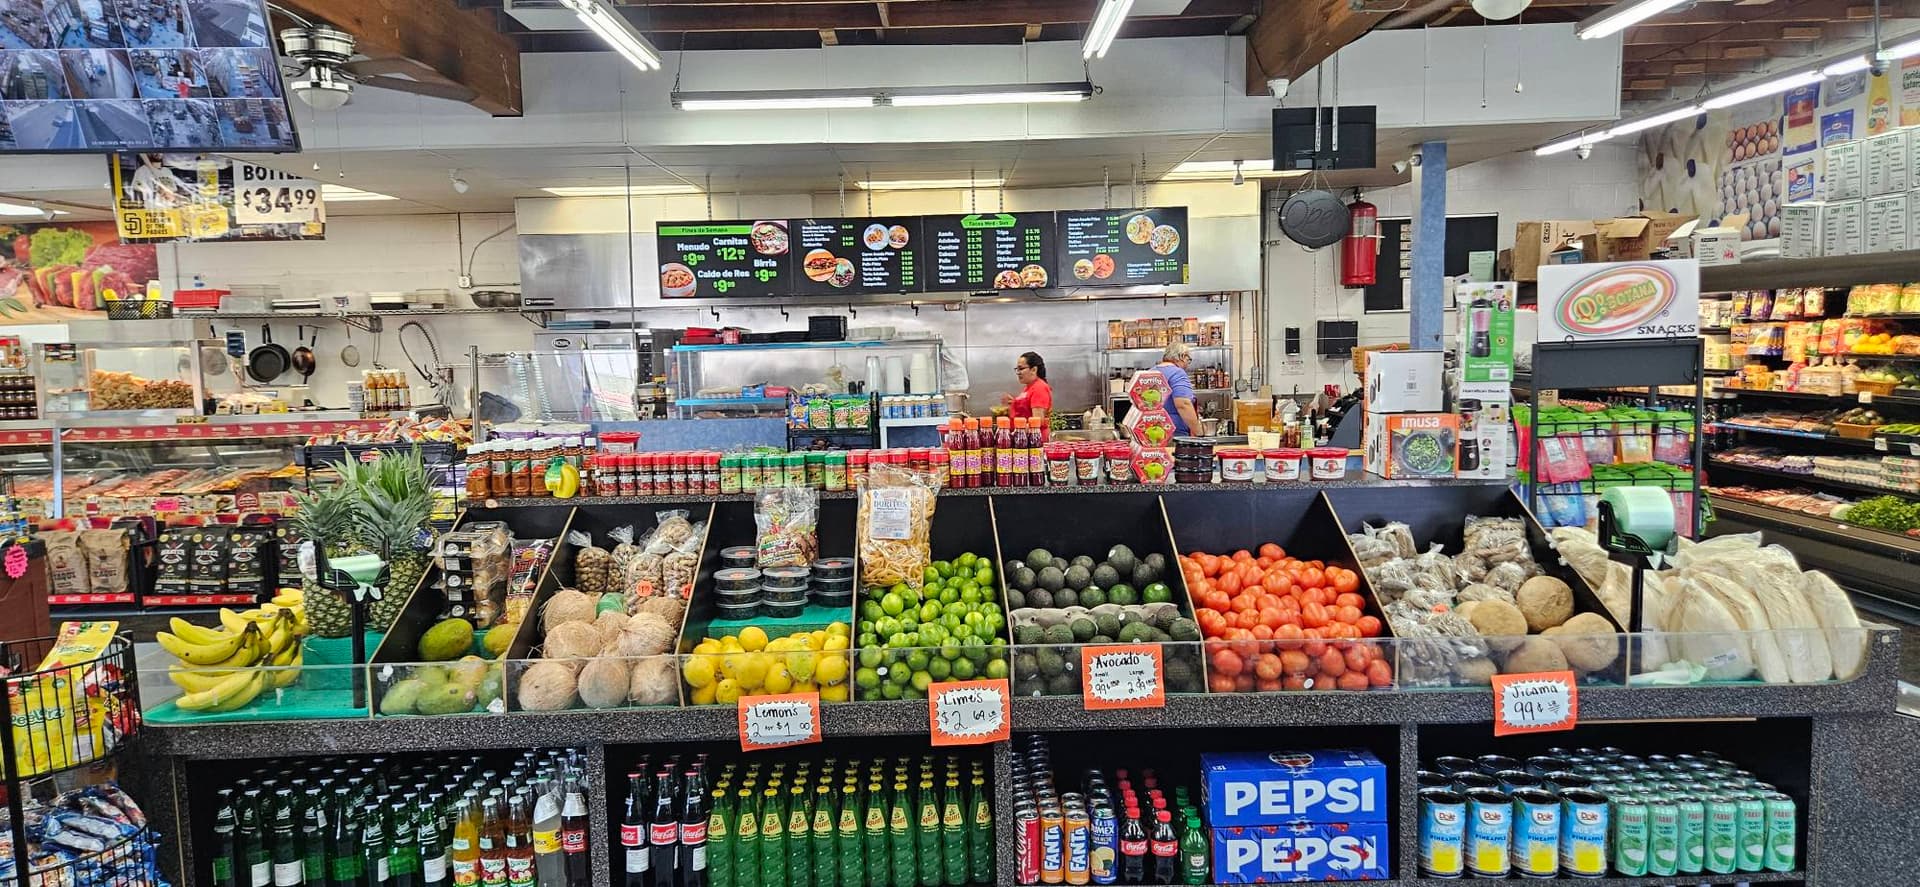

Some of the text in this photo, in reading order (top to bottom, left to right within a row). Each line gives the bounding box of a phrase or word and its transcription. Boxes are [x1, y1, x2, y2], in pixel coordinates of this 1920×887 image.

[713, 237, 748, 245] Carnitas
[677, 243, 710, 252] Menudo
[753, 259, 777, 267] Birria
[697, 269, 750, 278] Caldo de Res
[1637, 324, 1696, 335] SNACKS
[1401, 416, 1441, 428] imusa
[1096, 651, 1140, 669] Avocado
[1512, 684, 1558, 698] Jicama
[751, 722, 763, 738] 2
[1224, 777, 1375, 816] PEPSI
[1438, 812, 1457, 821] Dole
[1483, 811, 1502, 821] Dole
[1536, 812, 1553, 821] Dole
[1581, 811, 1598, 821] Dole
[740, 823, 757, 834] Squirt
[764, 824, 779, 834] Squirt
[790, 822, 806, 830] Squirt
[652, 828, 676, 839] Coca-Cola
[684, 827, 706, 839] Coca-Cola
[1429, 834, 1461, 842] PINEAPPLE
[1572, 834, 1604, 842] PINEAPPLE
[1043, 824, 1060, 871] FANTA
[1069, 826, 1087, 872] FANTA
[1126, 841, 1148, 852] Coca-Cola
[1153, 844, 1176, 853] Coca-Cola
[1226, 835, 1377, 873] PEPSI
